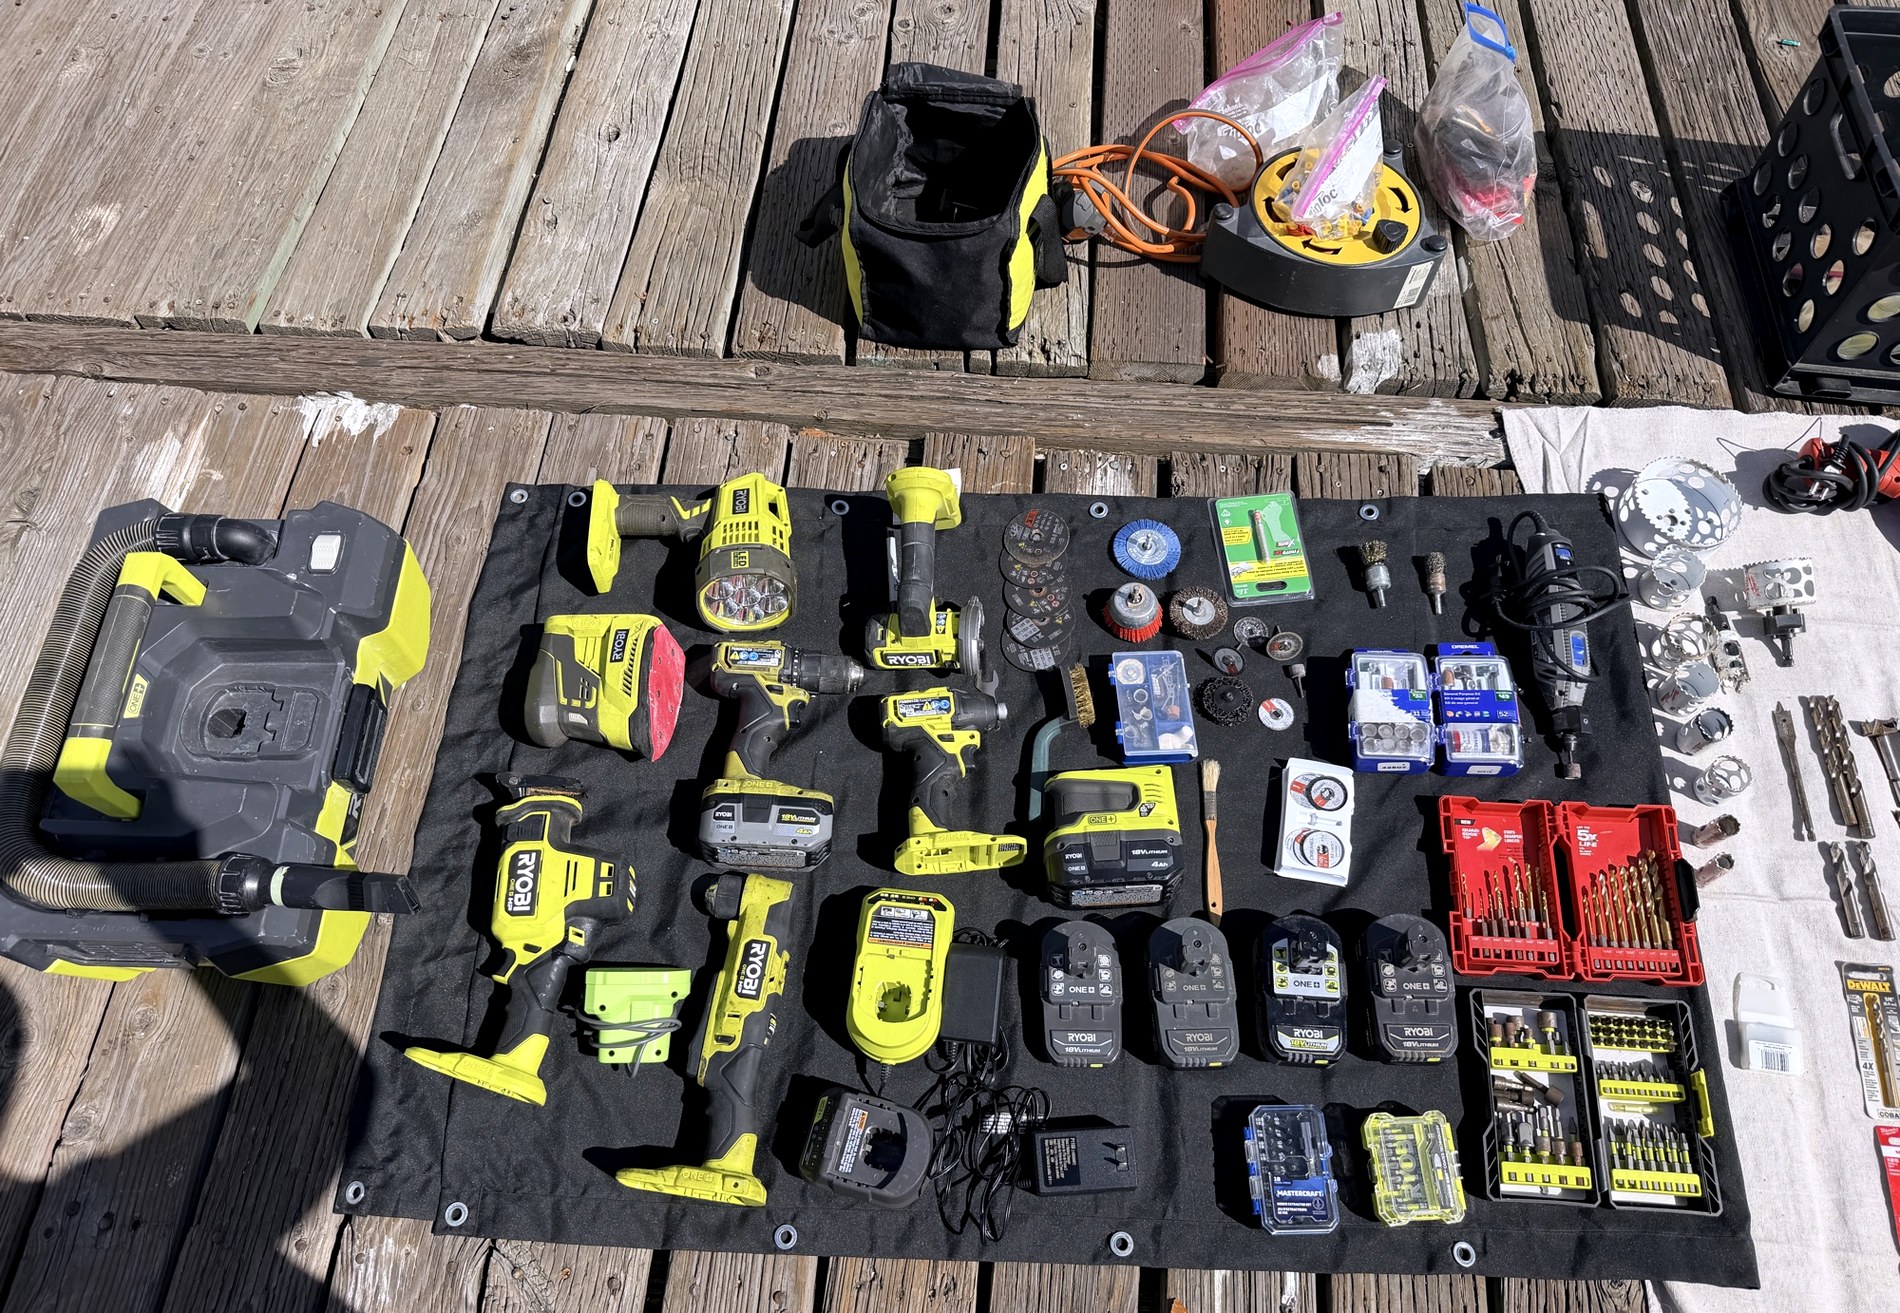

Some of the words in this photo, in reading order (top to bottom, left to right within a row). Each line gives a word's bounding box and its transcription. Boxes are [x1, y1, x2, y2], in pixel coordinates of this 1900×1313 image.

[735, 489, 747, 513] RYOBI
[738, 551, 747, 567] LED
[612, 630, 627, 662] RYOBI
[886, 655, 931, 665] RYOBI
[1064, 852, 1083, 860] RYOBI
[513, 852, 537, 912] RYOBI
[507, 897, 514, 912] HP
[741, 943, 767, 995] RYOBI
[737, 980, 743, 993] HP
[1846, 978, 1892, 993] DEWALT
[1067, 1033, 1096, 1042] RYOBI
[1185, 1033, 1213, 1042] RYOBI
[1293, 1028, 1323, 1039] RYOBI
[1404, 1027, 1434, 1037] RYOBI
[1862, 1061, 1874, 1071] 4X
